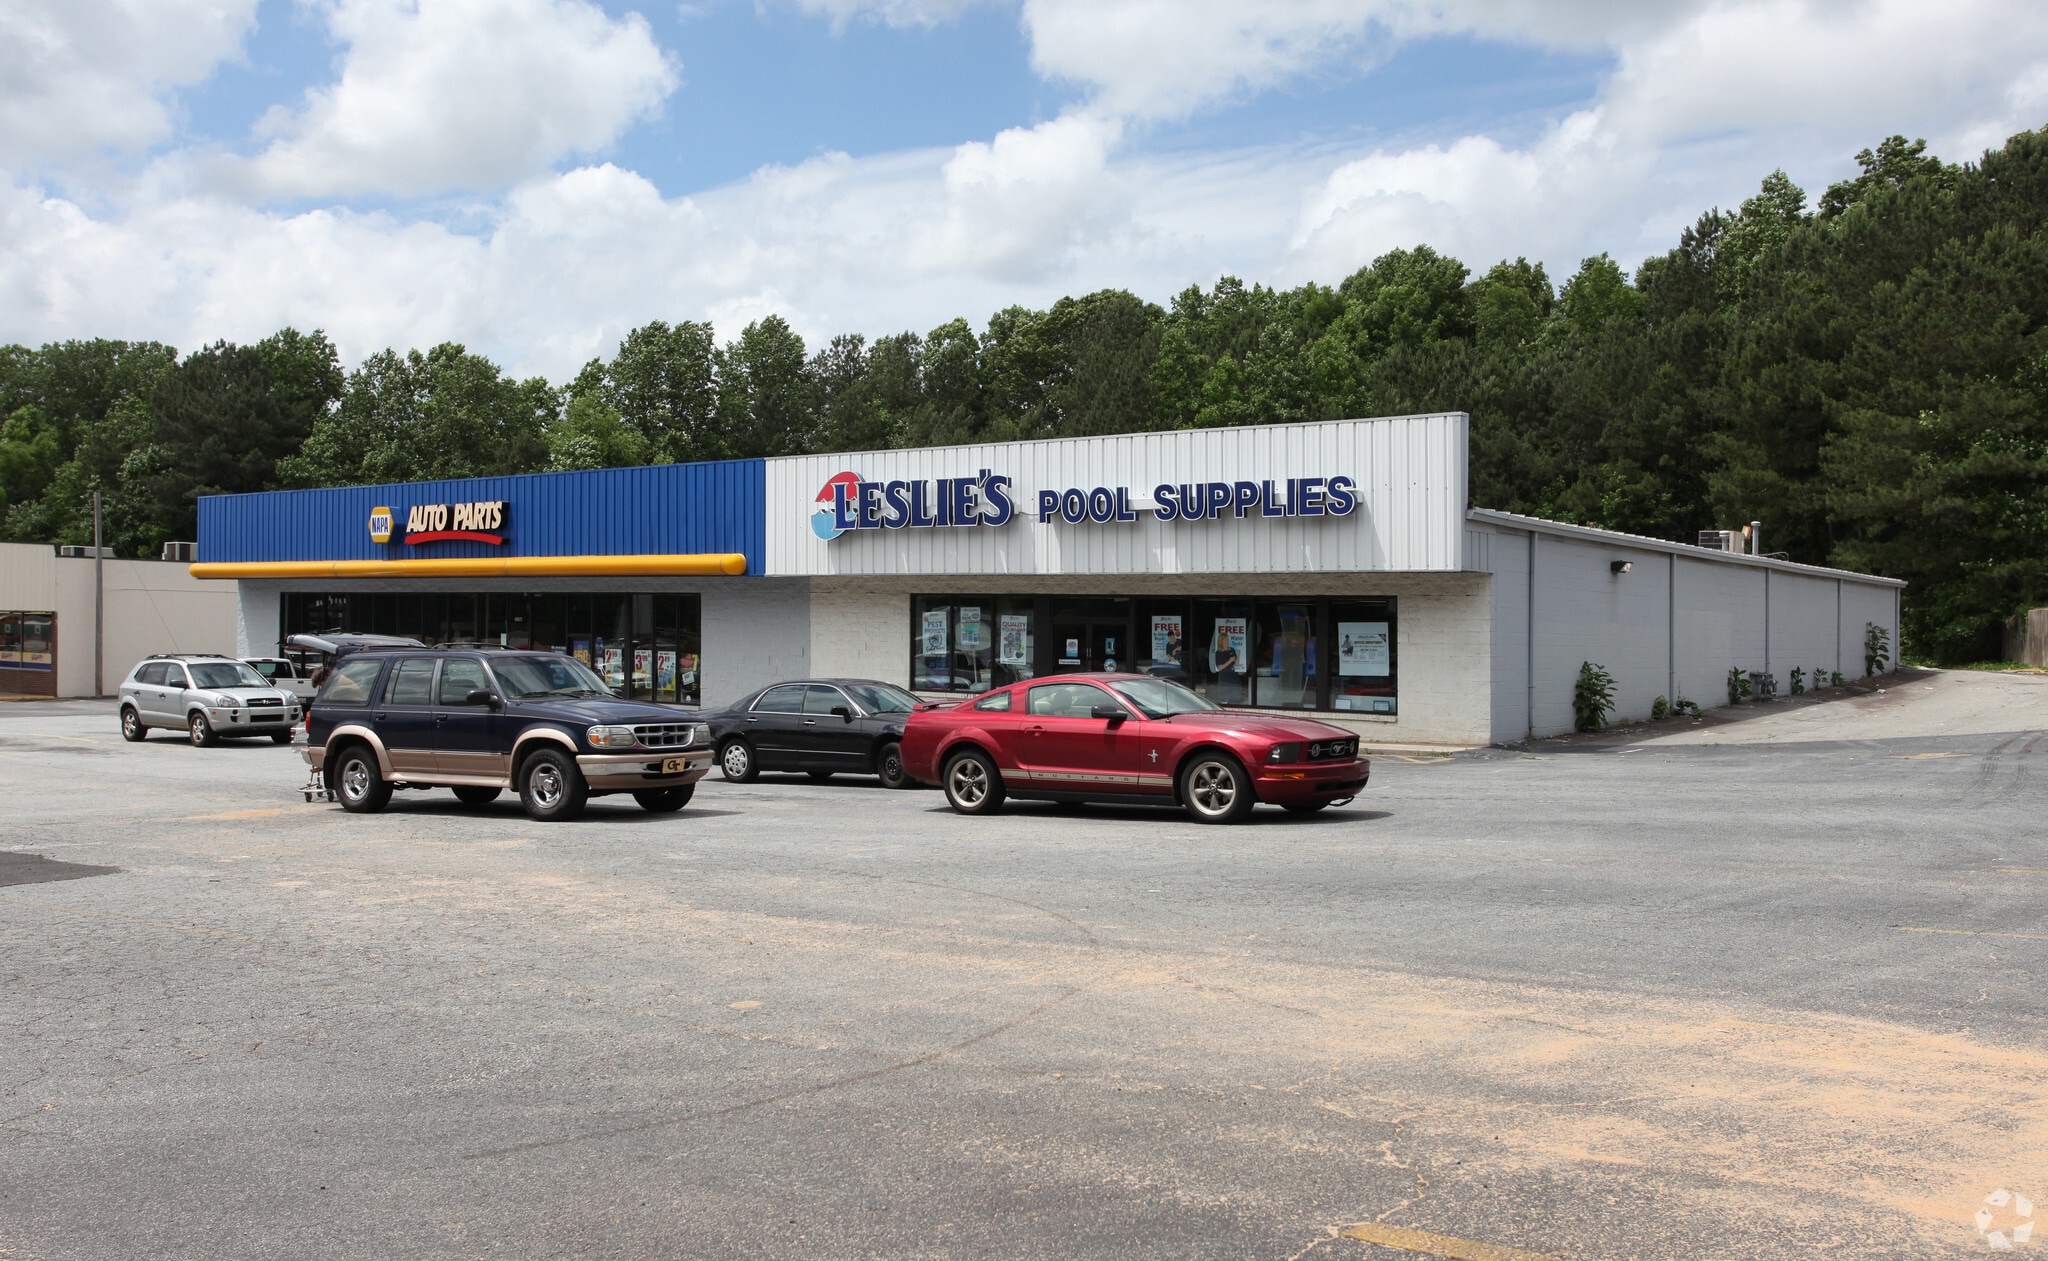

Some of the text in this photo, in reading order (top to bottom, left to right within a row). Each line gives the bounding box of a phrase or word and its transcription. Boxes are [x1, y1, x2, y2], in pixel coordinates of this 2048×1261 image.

[831, 468, 1358, 531] LESLIE'S POOL SUPPLIES
[405, 501, 503, 533] AUTO PARTS
[371, 516, 389, 533] NAPA
[1154, 623, 1180, 631] FREE
[1217, 625, 1245, 634] FREE
[1037, 773, 1129, 781] MUSTANG
